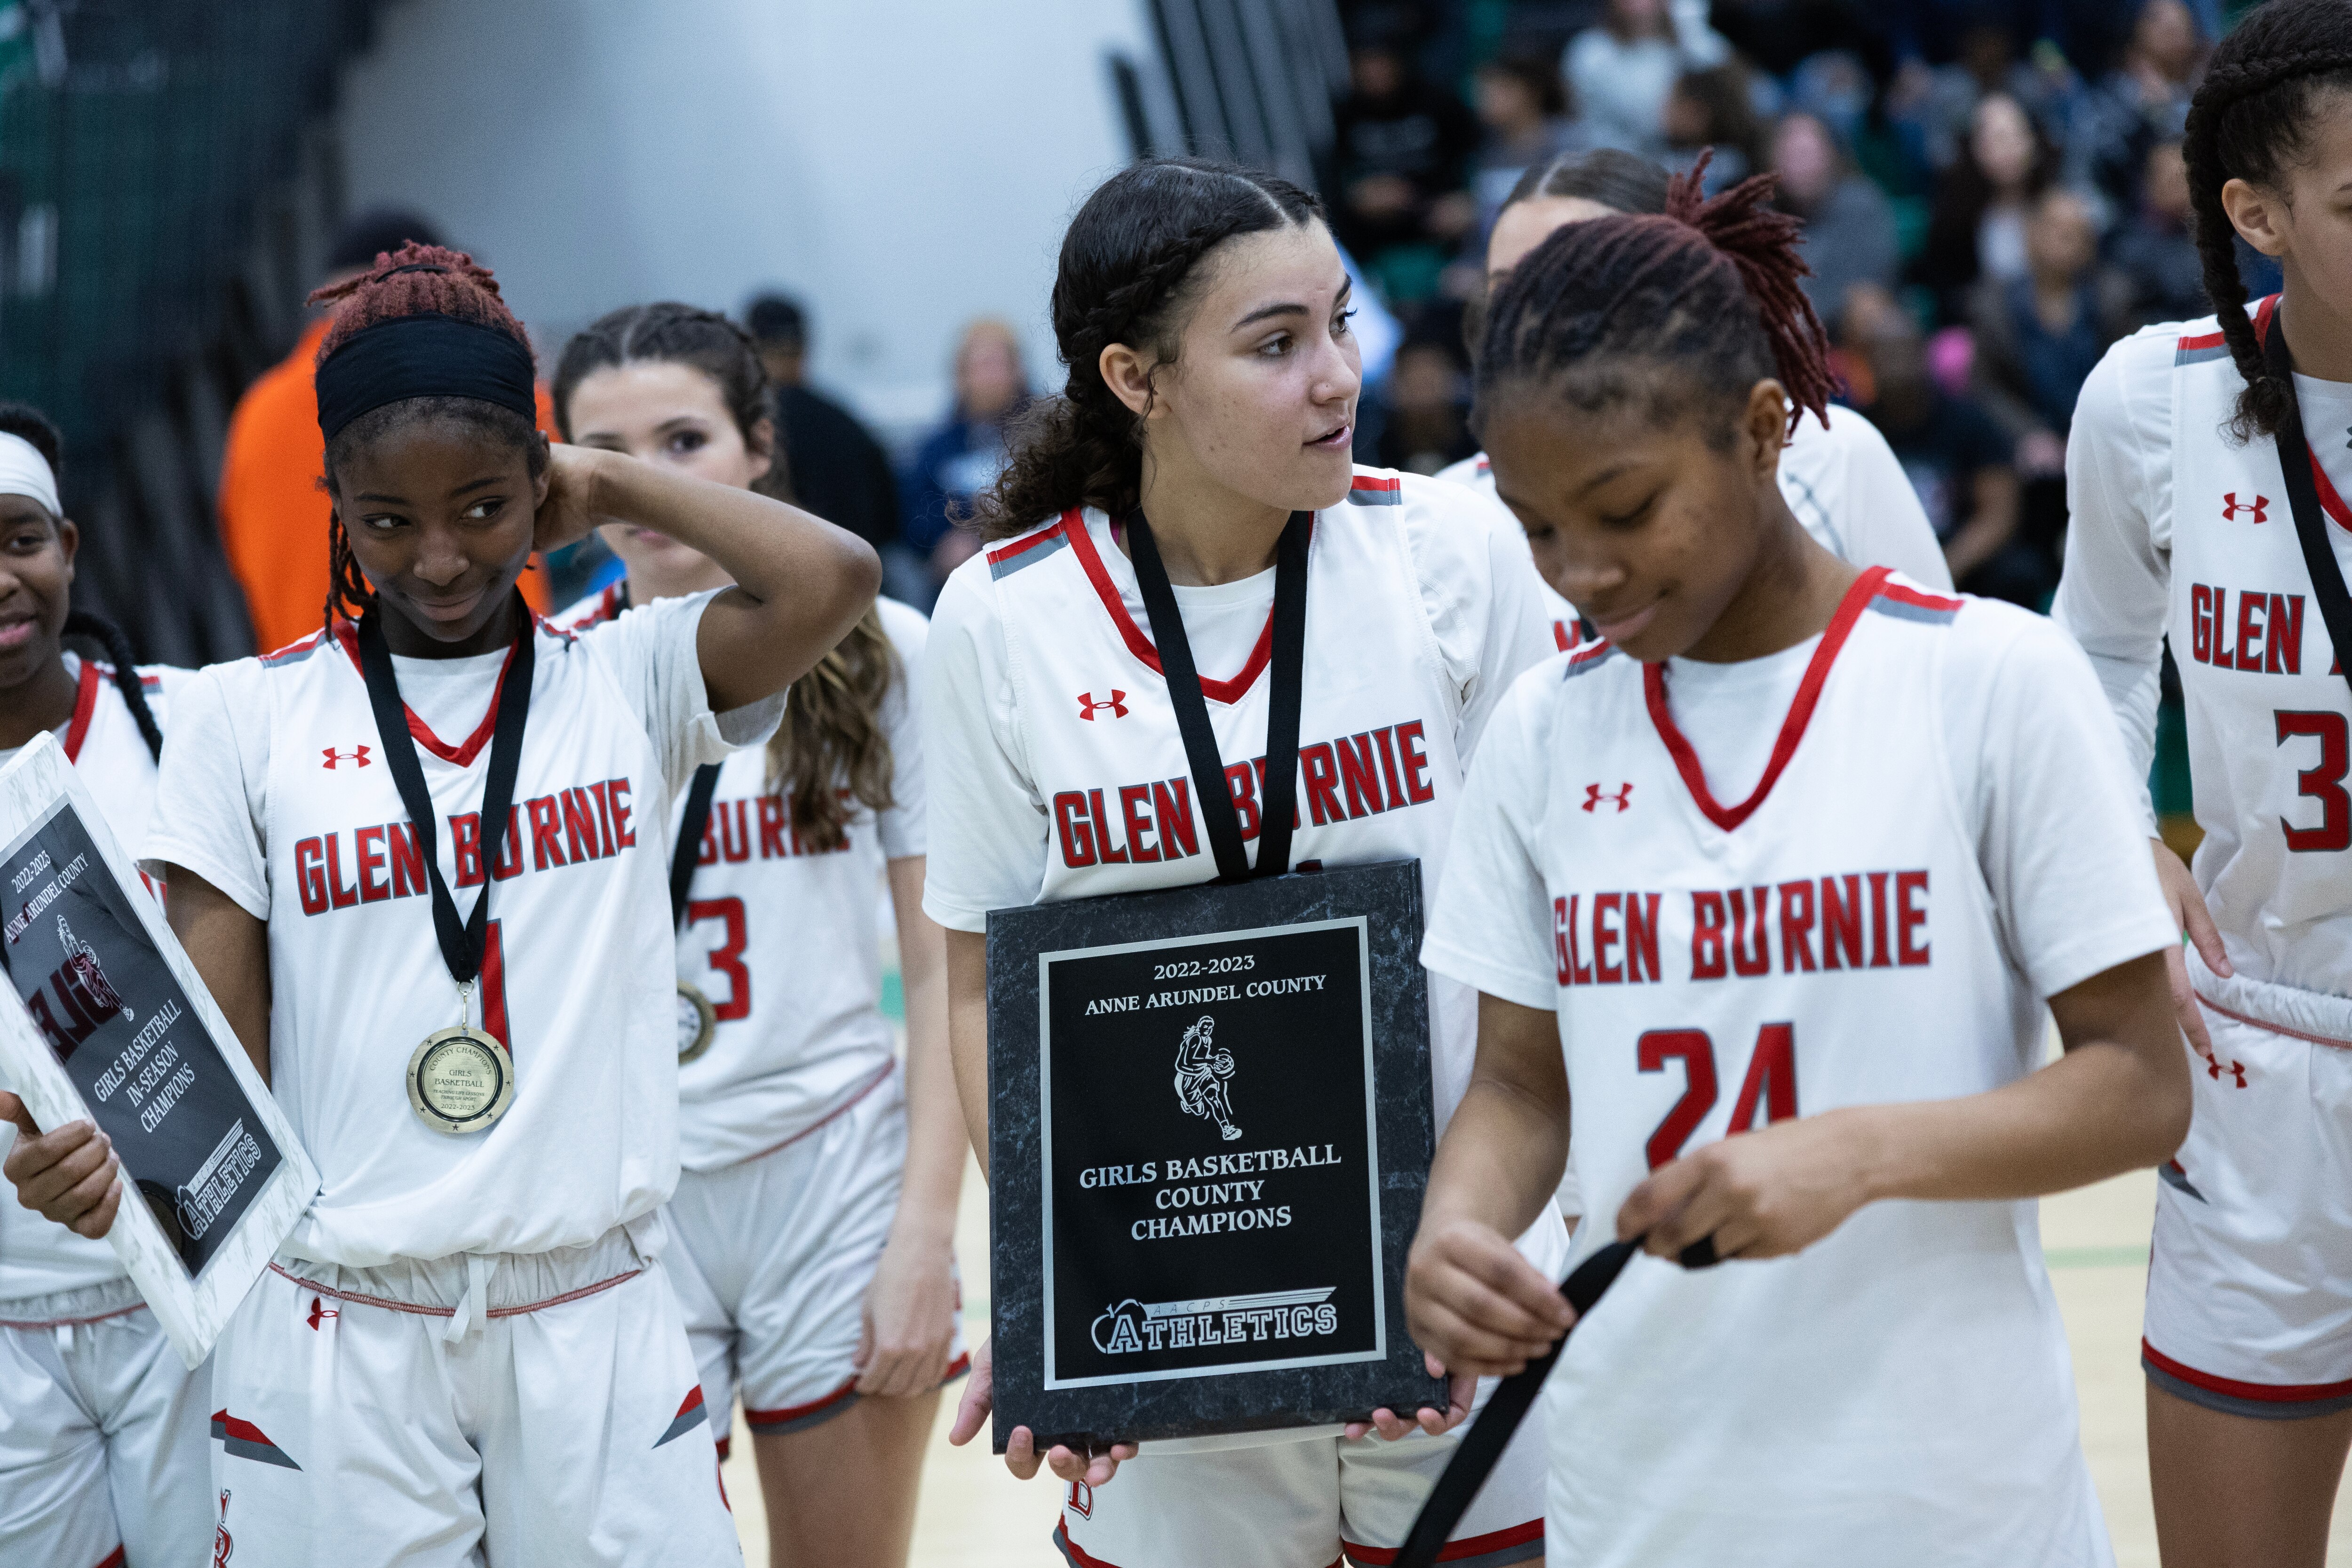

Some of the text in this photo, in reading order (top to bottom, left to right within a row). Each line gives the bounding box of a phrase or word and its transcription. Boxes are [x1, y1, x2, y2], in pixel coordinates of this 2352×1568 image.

[2191, 583, 2305, 675] GLEN
[1053, 719, 1435, 869] GLEN BRNIE
[2273, 709, 2352, 852] 3
[4, 852, 88, 943] ANNE ARUNDEL COUNTY
[11, 850, 51, 894] 2022-2023
[294, 822, 429, 917] GLEN
[688, 896, 751, 1022] 3
[1553, 868, 1931, 987] GLEN BURNIE
[1085, 975, 1327, 1015] ANNE ARUNDEL COUNTY
[1154, 955, 1255, 979] 2022-2023
[94, 999, 182, 1102] GIRLS BASKETBALL
[126, 1040, 179, 1107] IN-SEASON
[429, 1047, 492, 1075] COUNTY CHAMPIONS
[435, 1078, 484, 1088] BASKETBALL
[141, 1062, 195, 1133] CHAMPIONS
[1637, 1020, 1799, 1173] 24
[183, 1133, 262, 1240] ATHLETICS
[191, 1158, 216, 1192] AACPS
[1079, 1144, 1342, 1189] GIRLS BASKETBALL
[1156, 1180, 1265, 1209] COUNTY
[1131, 1206, 1292, 1240] CHAMPIONS
[1107, 1304, 1337, 1354] ATHLETICS
[1153, 1300, 1225, 1315] AACPS
